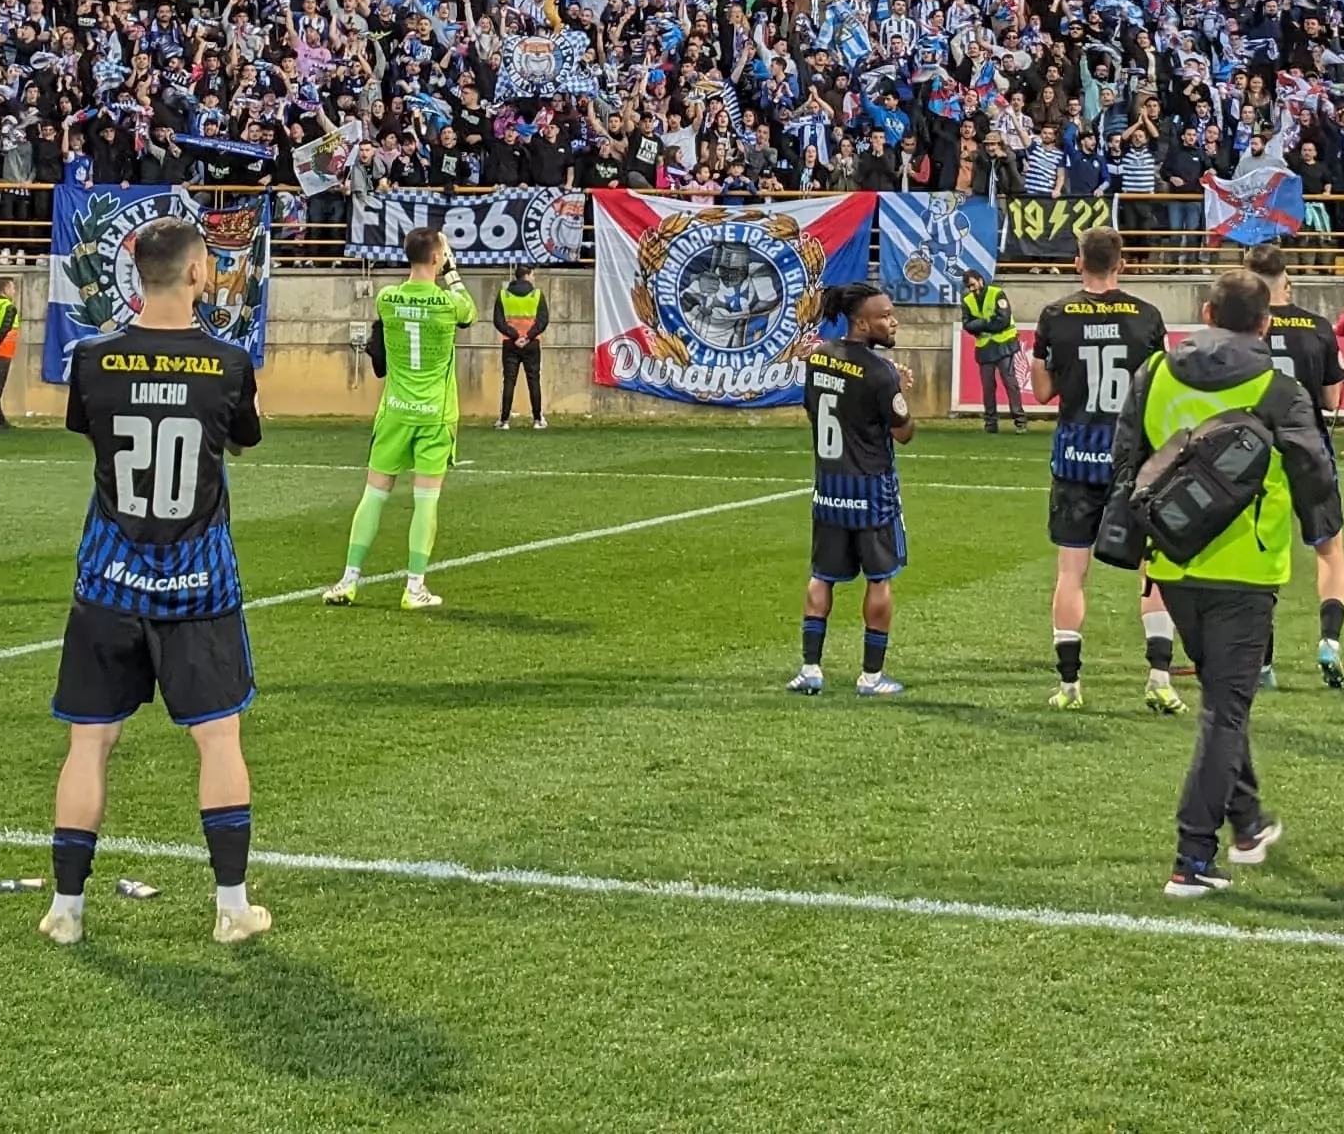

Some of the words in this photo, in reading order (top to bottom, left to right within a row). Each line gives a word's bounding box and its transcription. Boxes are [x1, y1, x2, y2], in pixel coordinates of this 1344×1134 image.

[443, 201, 518, 251] 86
[1010, 198, 1045, 242] 19
[741, 224, 785, 259] 1922
[382, 294, 405, 304] CAJA
[1064, 303, 1094, 314] CAJA
[1084, 323, 1120, 339] MARKEL
[404, 322, 421, 370] 1
[102, 354, 149, 372] CAJA
[1078, 345, 1130, 413] 16
[131, 383, 188, 406] LANCHO
[817, 393, 844, 459] 6
[113, 415, 203, 519] 20
[1076, 451, 1113, 464] VALCA
[819, 496, 868, 510] VALCARCE
[124, 571, 209, 592] VALCARCE
